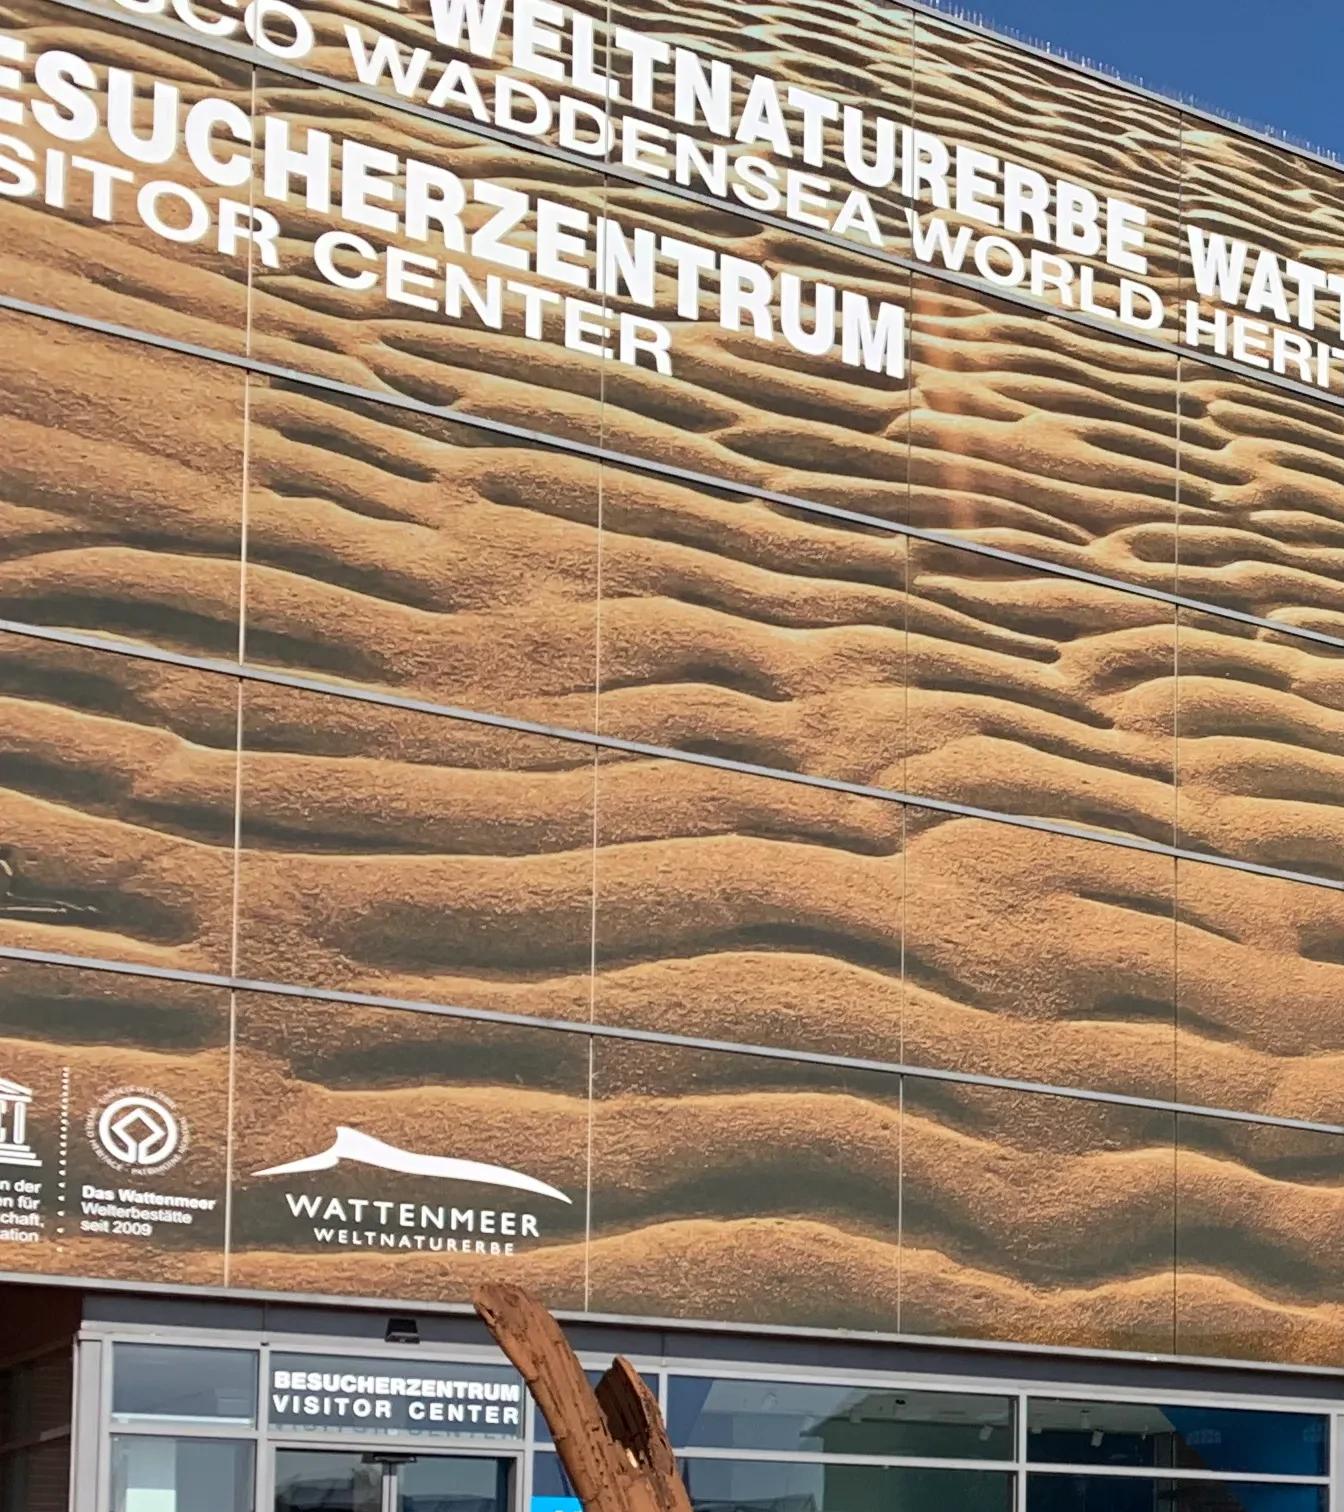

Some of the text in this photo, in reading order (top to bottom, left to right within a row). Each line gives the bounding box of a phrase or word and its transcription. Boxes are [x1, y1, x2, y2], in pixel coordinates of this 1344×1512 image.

[430, 0, 1148, 275] WELTNATURERBE
[343, 24, 884, 247] WADDENSEA
[909, 209, 1165, 330] WORLD
[313, 231, 674, 378] CENTER
[14, 1179, 42, 1193] der
[82, 1185, 217, 1210] Das Wattenmeer
[17, 1195, 40, 1209] für
[81, 1202, 193, 1224] Welterbestätte
[285, 1193, 541, 1238] WATTENMEER
[80, 1218, 153, 1237] seit 2009
[313, 1227, 516, 1257] WELTNATURERBE
[273, 1370, 520, 1402] BESUCHERZENTRUM
[272, 1394, 520, 1425] VISITOR CENTER
